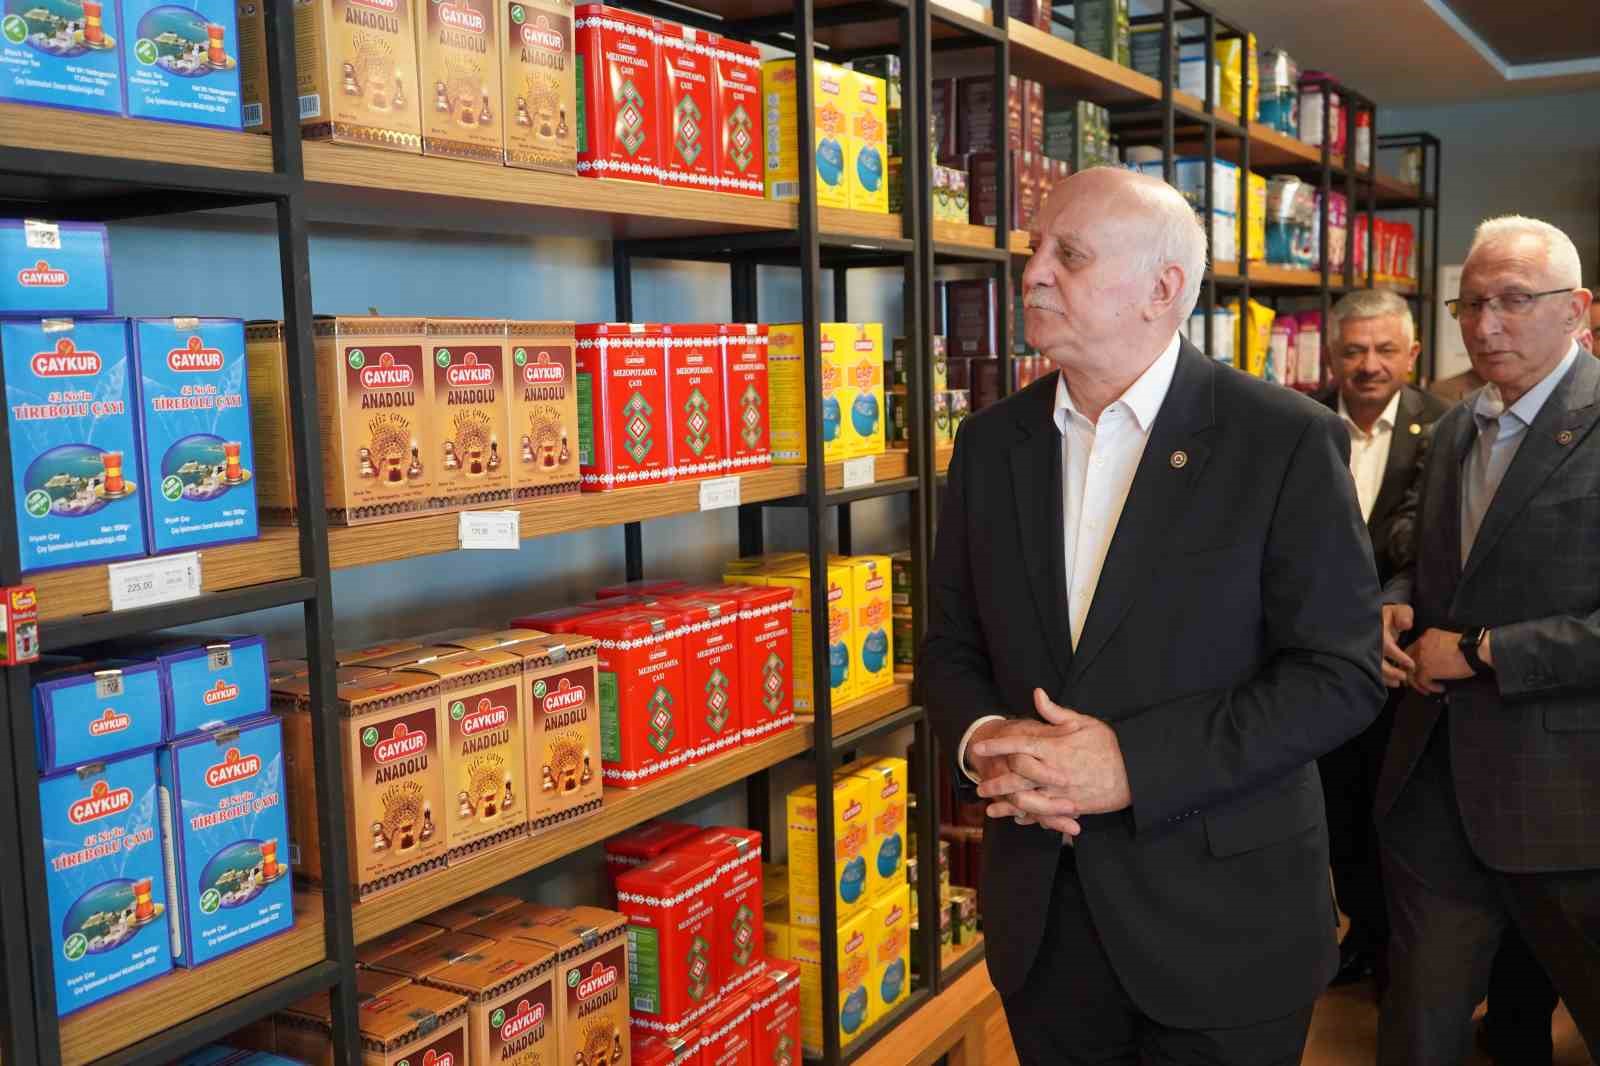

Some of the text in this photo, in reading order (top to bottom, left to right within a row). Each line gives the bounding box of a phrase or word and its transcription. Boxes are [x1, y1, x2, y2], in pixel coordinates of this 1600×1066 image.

[345, 8, 398, 33] ANADOLU
[439, 30, 487, 55] ANADOLU
[520, 48, 565, 71] ANADOLU
[36, 356, 97, 376] ÇAYKUR
[171, 353, 221, 371] ÇAYKUR
[362, 390, 416, 410] ANADOLU
[447, 388, 495, 406] ANADOLU
[524, 386, 565, 403] ANADOLU
[544, 707, 588, 732] ANADOLU
[377, 735, 424, 763] ÇAYKUR
[462, 730, 510, 756] ANADOLU
[209, 757, 258, 785] ÇAYKUR
[375, 755, 428, 785] ANADOLU
[73, 791, 131, 822] ÇAYKUR
[577, 985, 618, 1019] ANADOLU
[501, 1022, 545, 1062] ANADOLU
